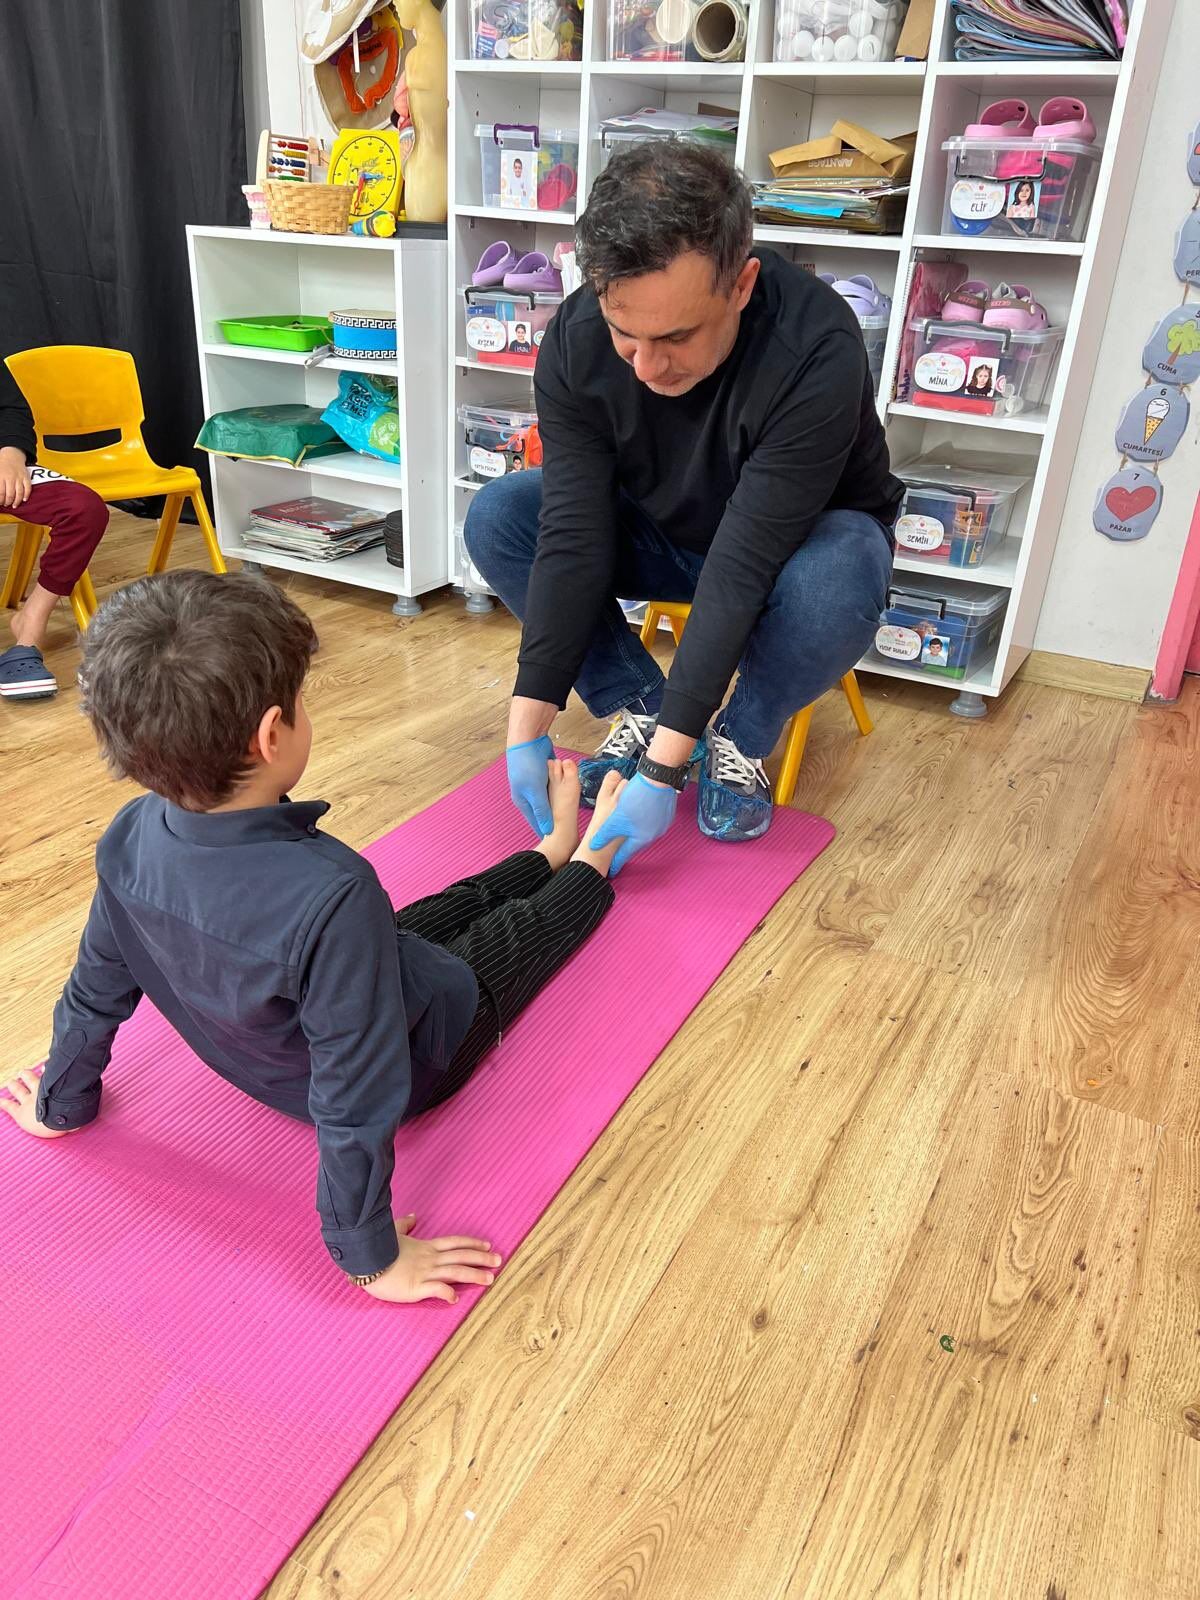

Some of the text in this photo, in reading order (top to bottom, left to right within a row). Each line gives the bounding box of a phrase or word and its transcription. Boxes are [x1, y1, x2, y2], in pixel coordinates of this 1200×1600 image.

[1157, 362, 1177, 375] CUMA
[928, 375, 948, 387] MİNA
[1160, 388, 1167, 396] 6
[1122, 442, 1164, 457] CUMARTESİ
[31, 468, 69, 480] RO
[1133, 472, 1140, 481] 7
[1109, 523, 1132, 533] PAZAR
[906, 534, 929, 545] SEMİH
